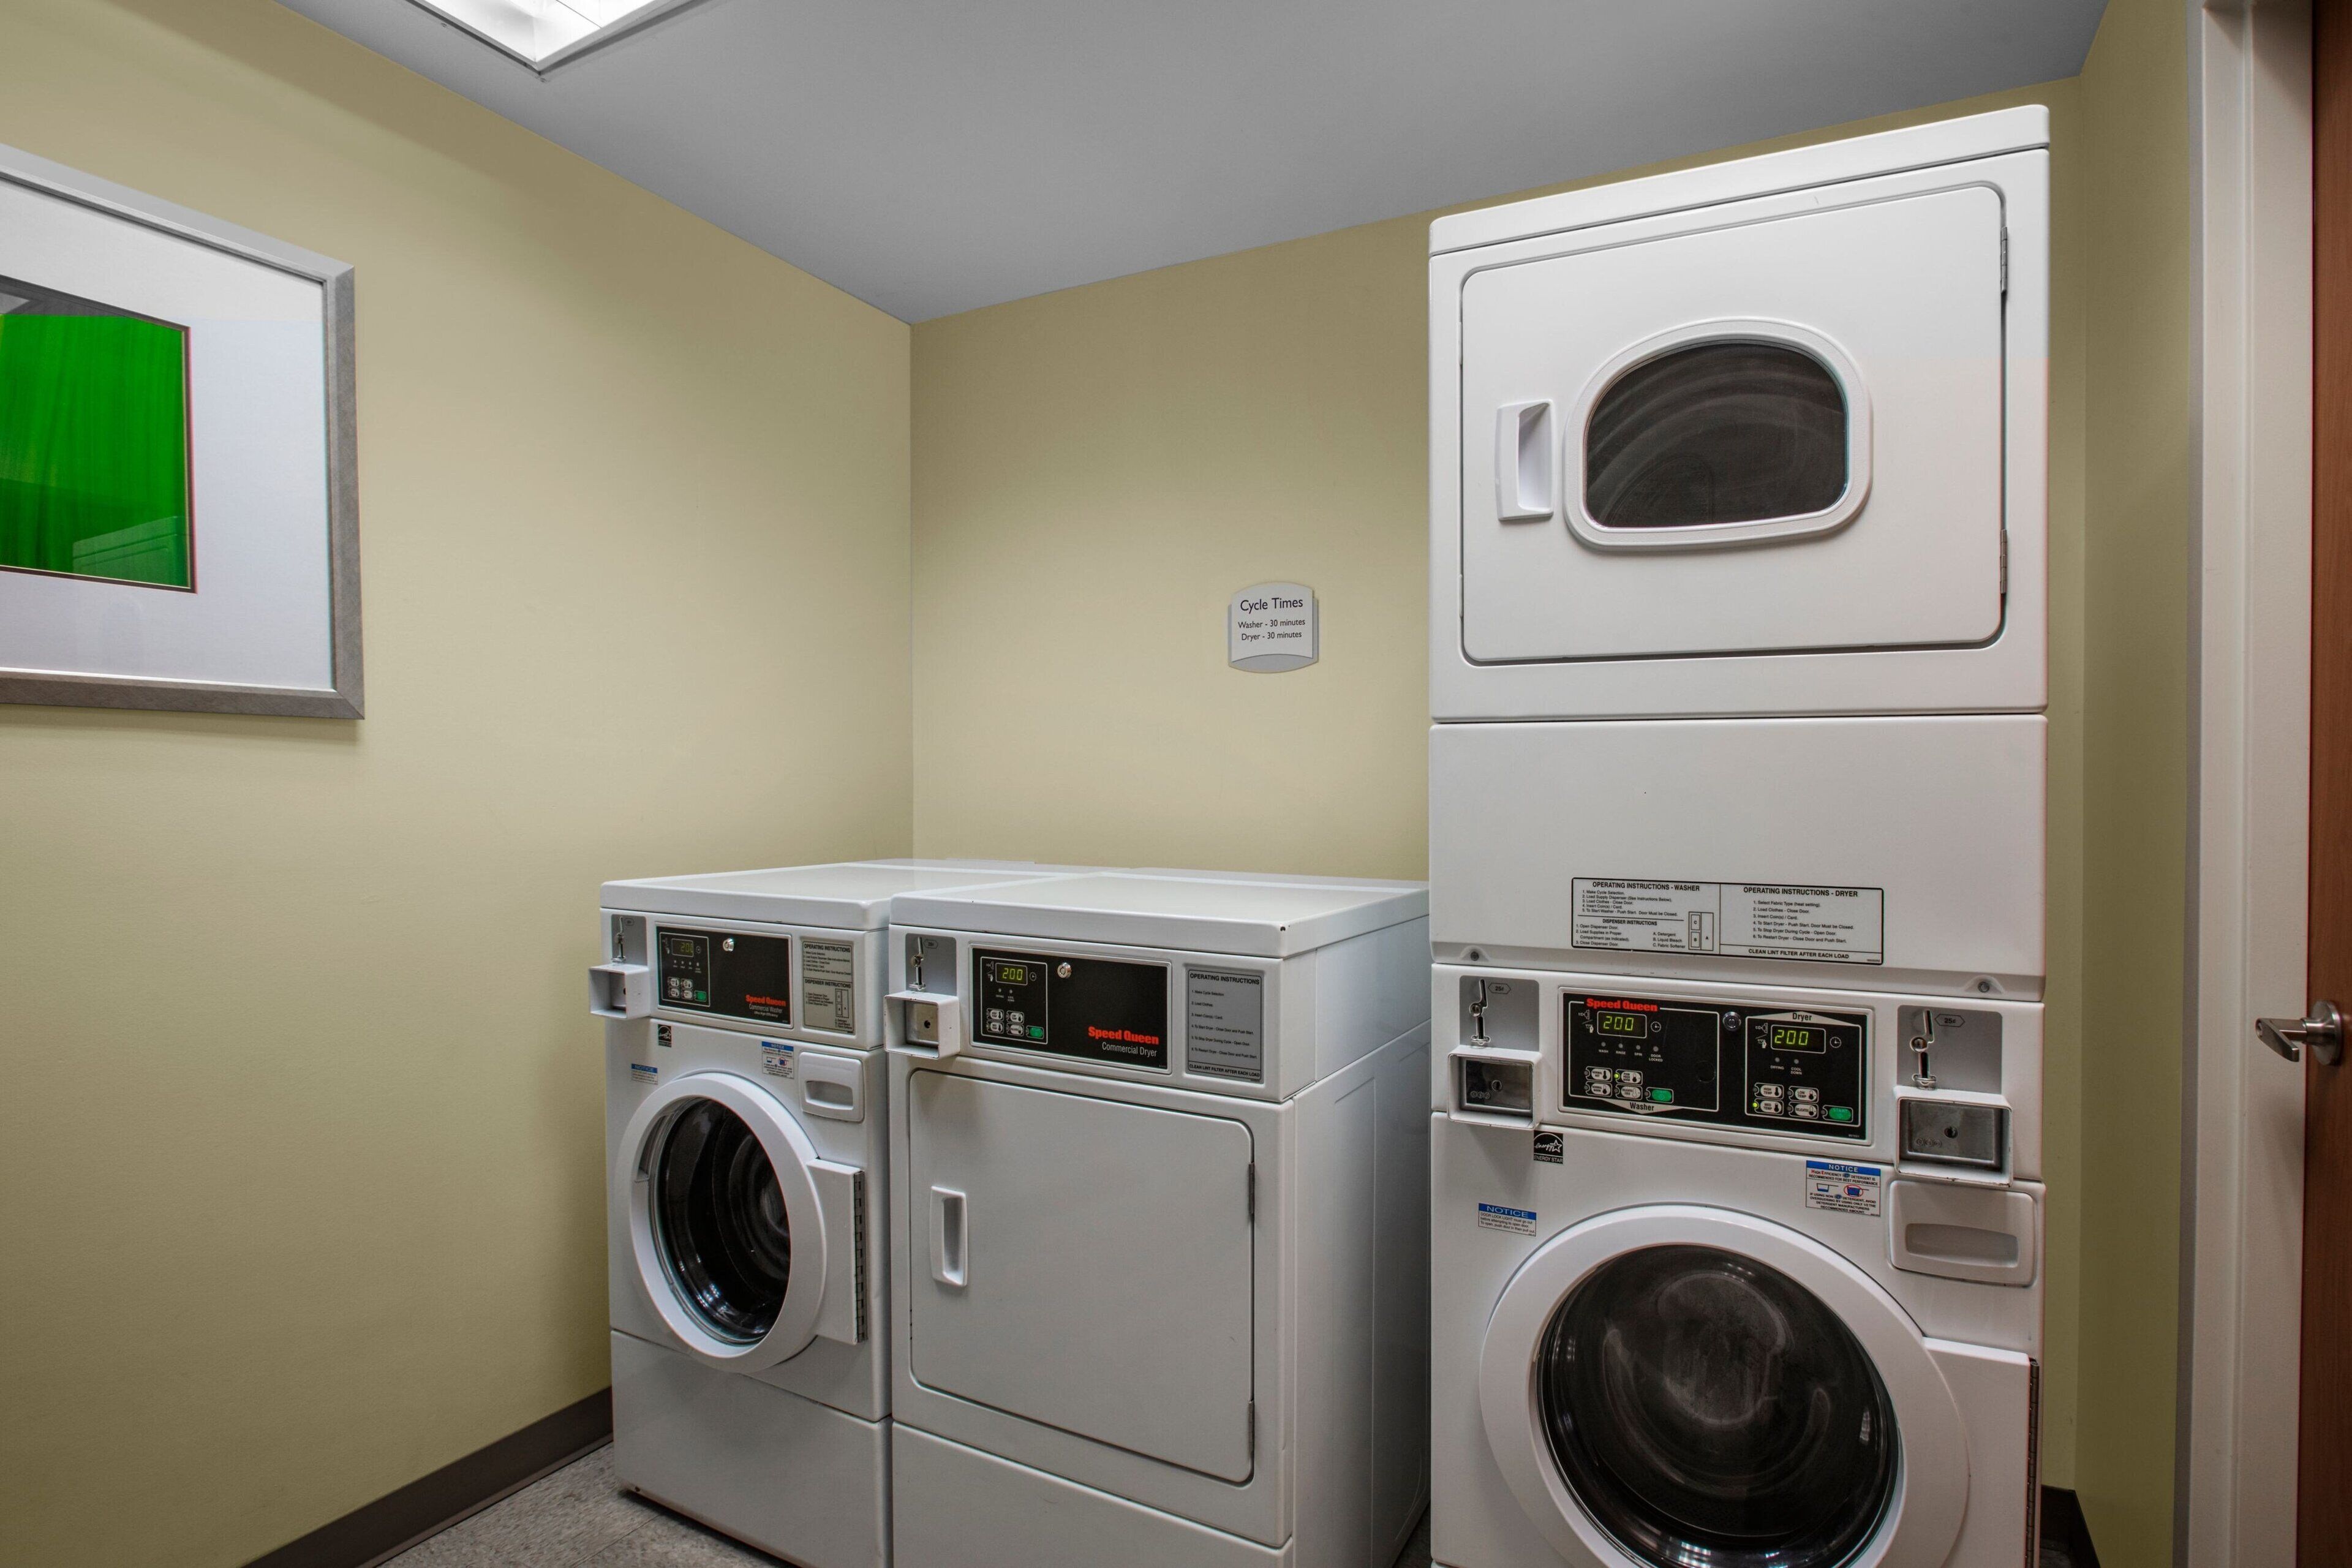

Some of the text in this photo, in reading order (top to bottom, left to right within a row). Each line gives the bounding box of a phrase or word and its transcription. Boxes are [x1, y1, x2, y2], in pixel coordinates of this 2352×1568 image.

[1240, 597, 1303, 614] Cycle Times
[1242, 633, 1260, 642] Dryer
[1002, 968, 1023, 981] 200
[1221, 976, 1260, 985] INSTRUCTIONS
[745, 995, 786, 1007] Speed Queen
[1586, 998, 1658, 1011] Speed Queen
[1792, 1012, 1812, 1021] Dryer
[1603, 1016, 1634, 1031] 200
[1088, 1025, 1159, 1045] Speed Queen
[1774, 1030, 1809, 1046] 200
[1102, 1041, 1158, 1058] Commercial Dryer
[1629, 1102, 1654, 1111] Washer
[1487, 1205, 1529, 1218] NOTICE
